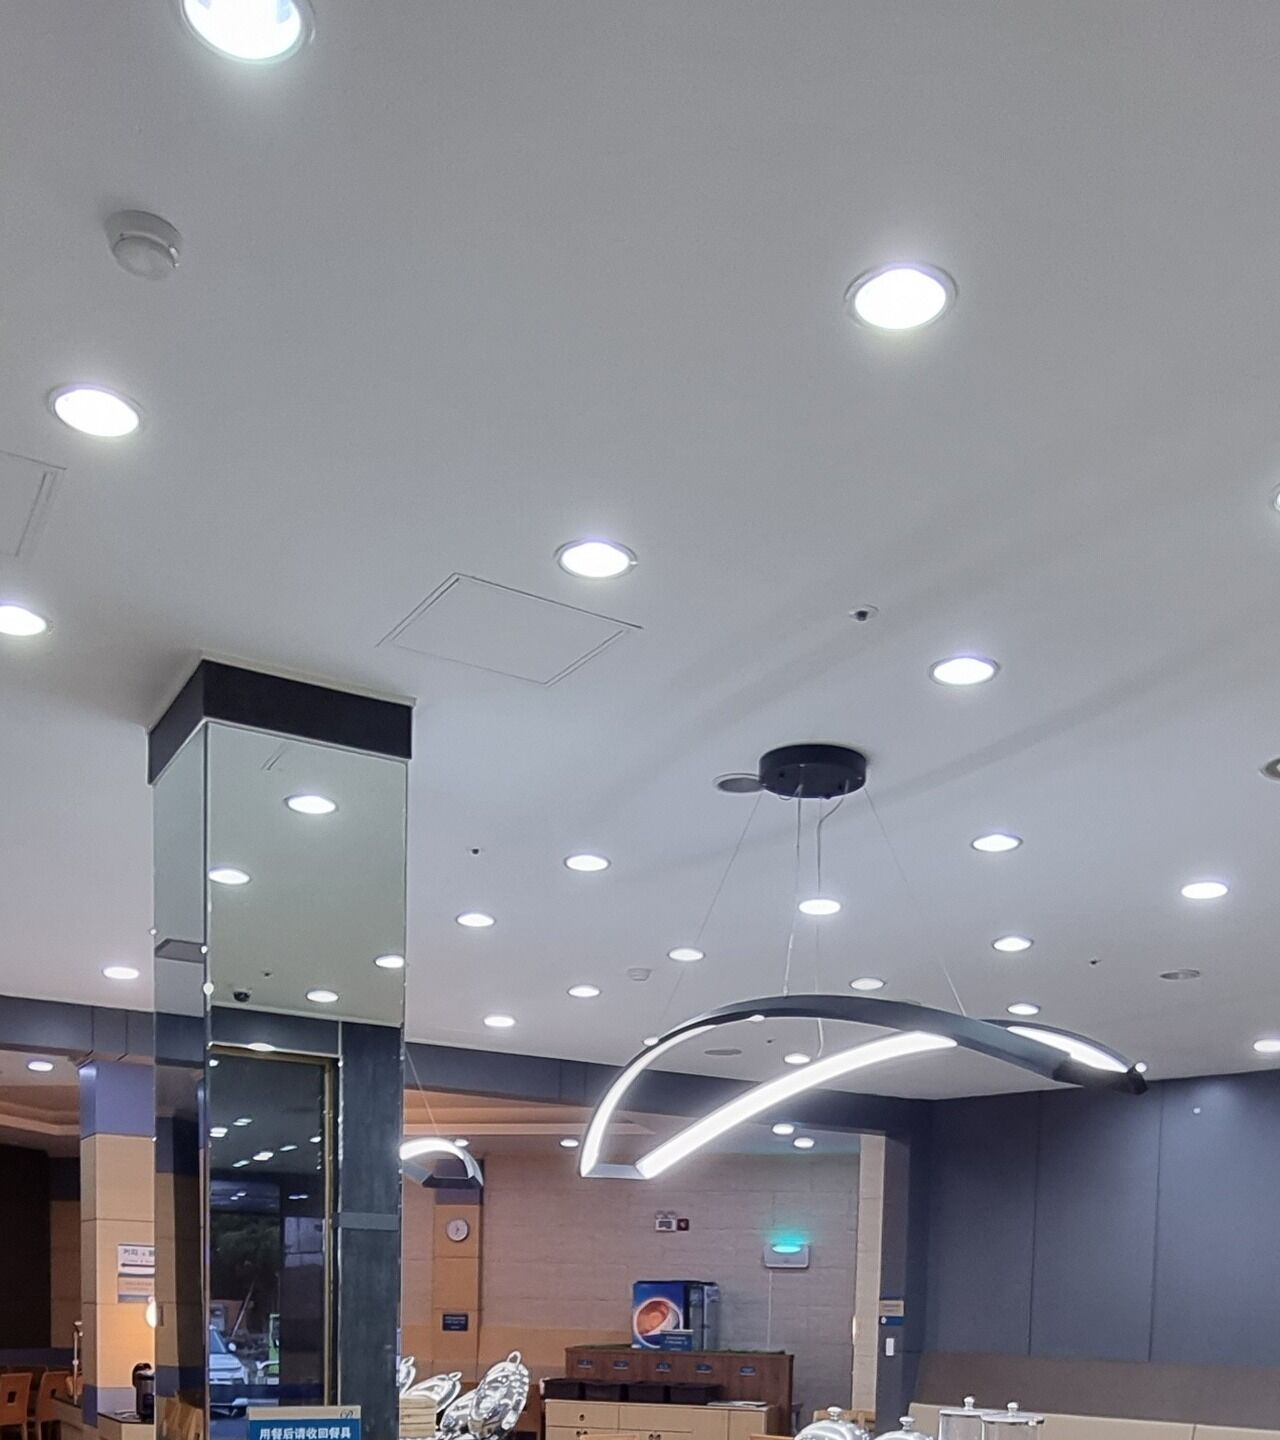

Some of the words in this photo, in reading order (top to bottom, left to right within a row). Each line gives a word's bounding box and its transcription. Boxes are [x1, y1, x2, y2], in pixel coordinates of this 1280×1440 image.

[259, 1427, 351, 1440] 用餐后请收回餐具
